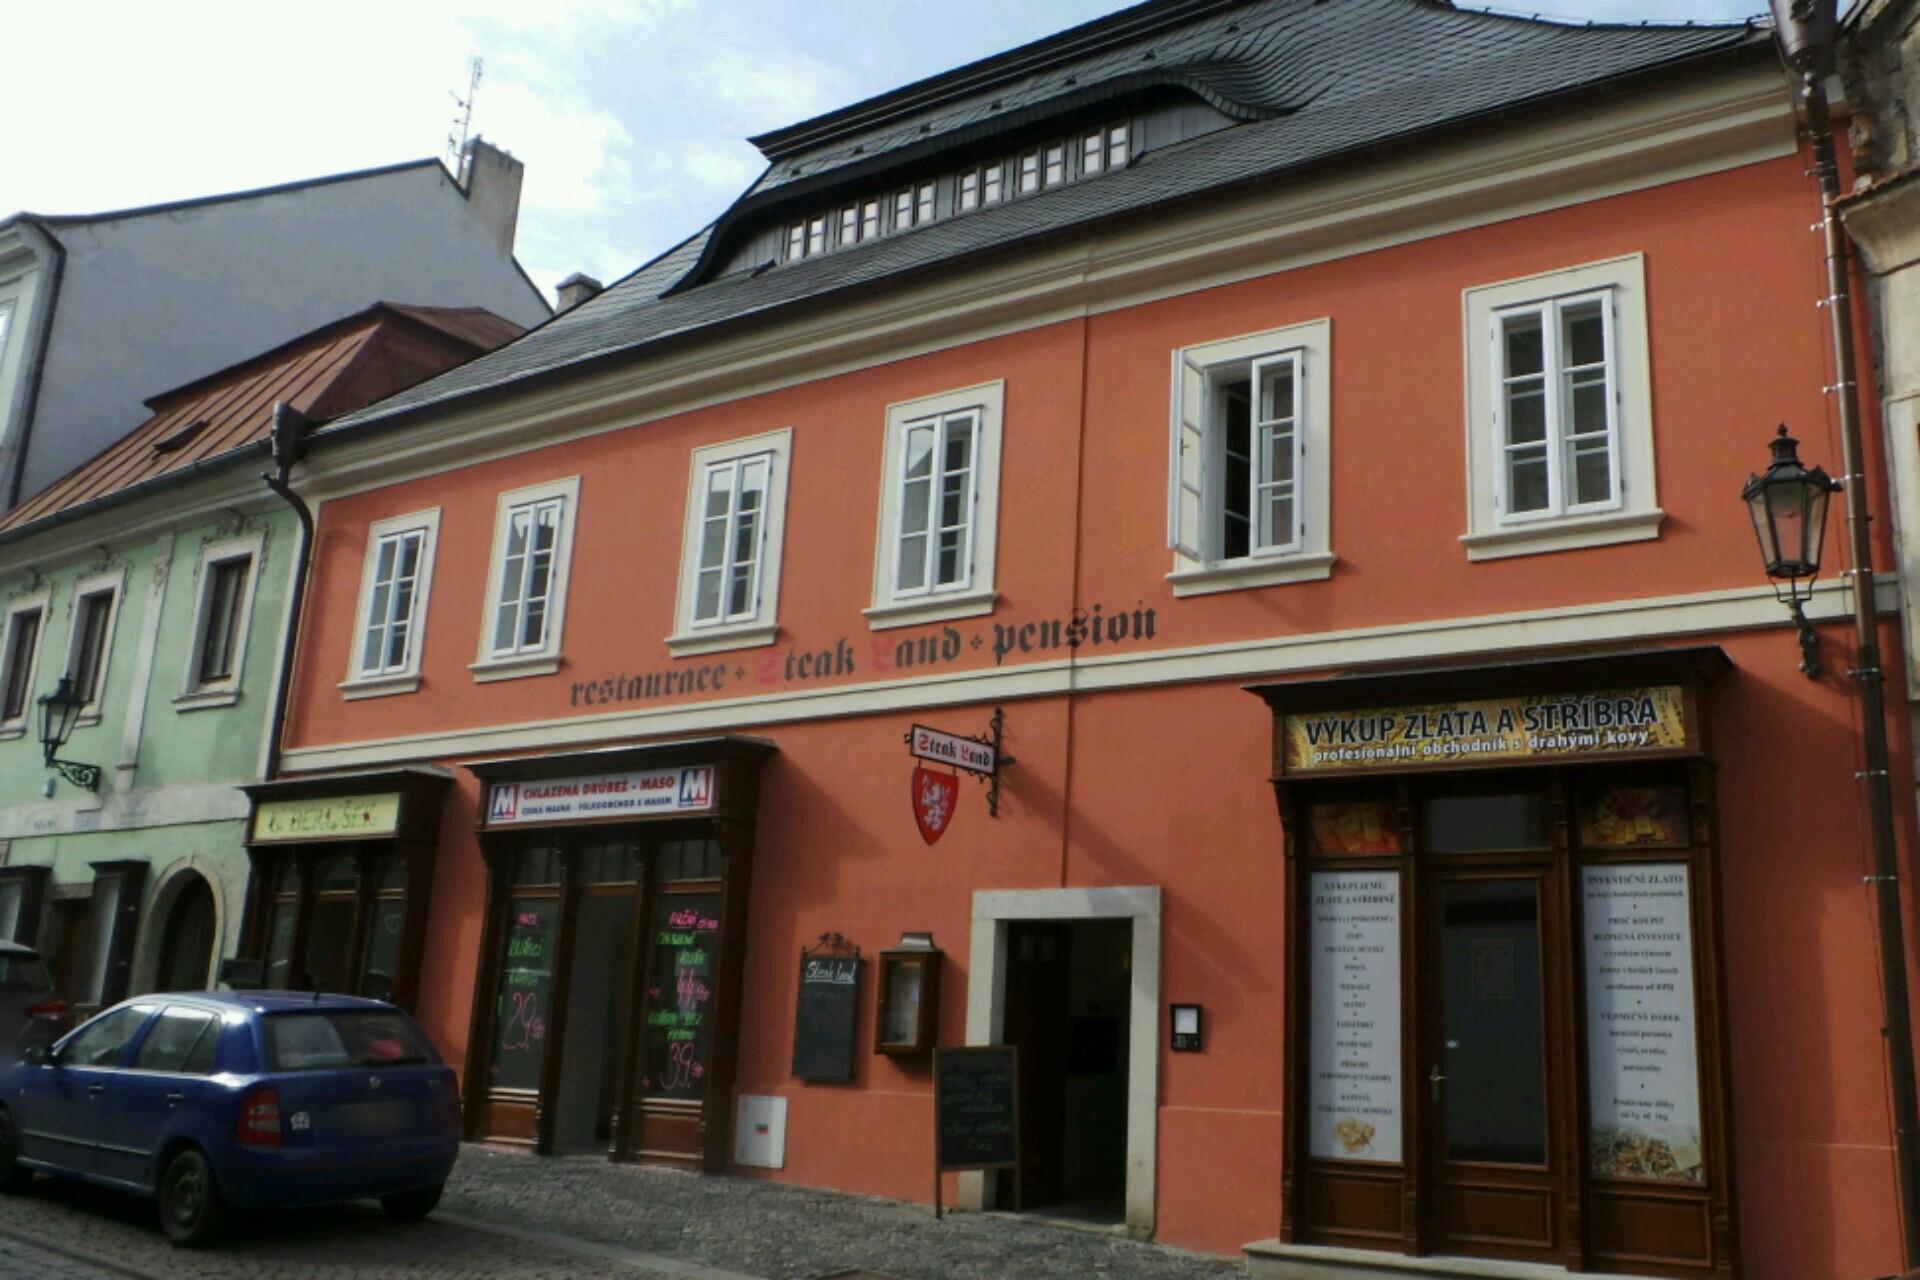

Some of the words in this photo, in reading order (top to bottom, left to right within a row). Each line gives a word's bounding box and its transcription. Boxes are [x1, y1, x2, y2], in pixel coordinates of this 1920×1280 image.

[569, 664, 727, 707] restaurace
[756, 636, 855, 686] Steak
[870, 625, 961, 672] Land
[993, 600, 1157, 666] pension
[1305, 715, 1396, 746] VÝKUP
[1403, 709, 1489, 740] ZLATA
[1496, 709, 1515, 733] A
[1524, 696, 1659, 732] STŘÍBRA
[918, 732, 957, 758] Steak
[961, 744, 991, 767] Land
[1528, 730, 1600, 750] drahými
[1607, 729, 1649, 747] kovy
[640, 776, 676, 791] MASO
